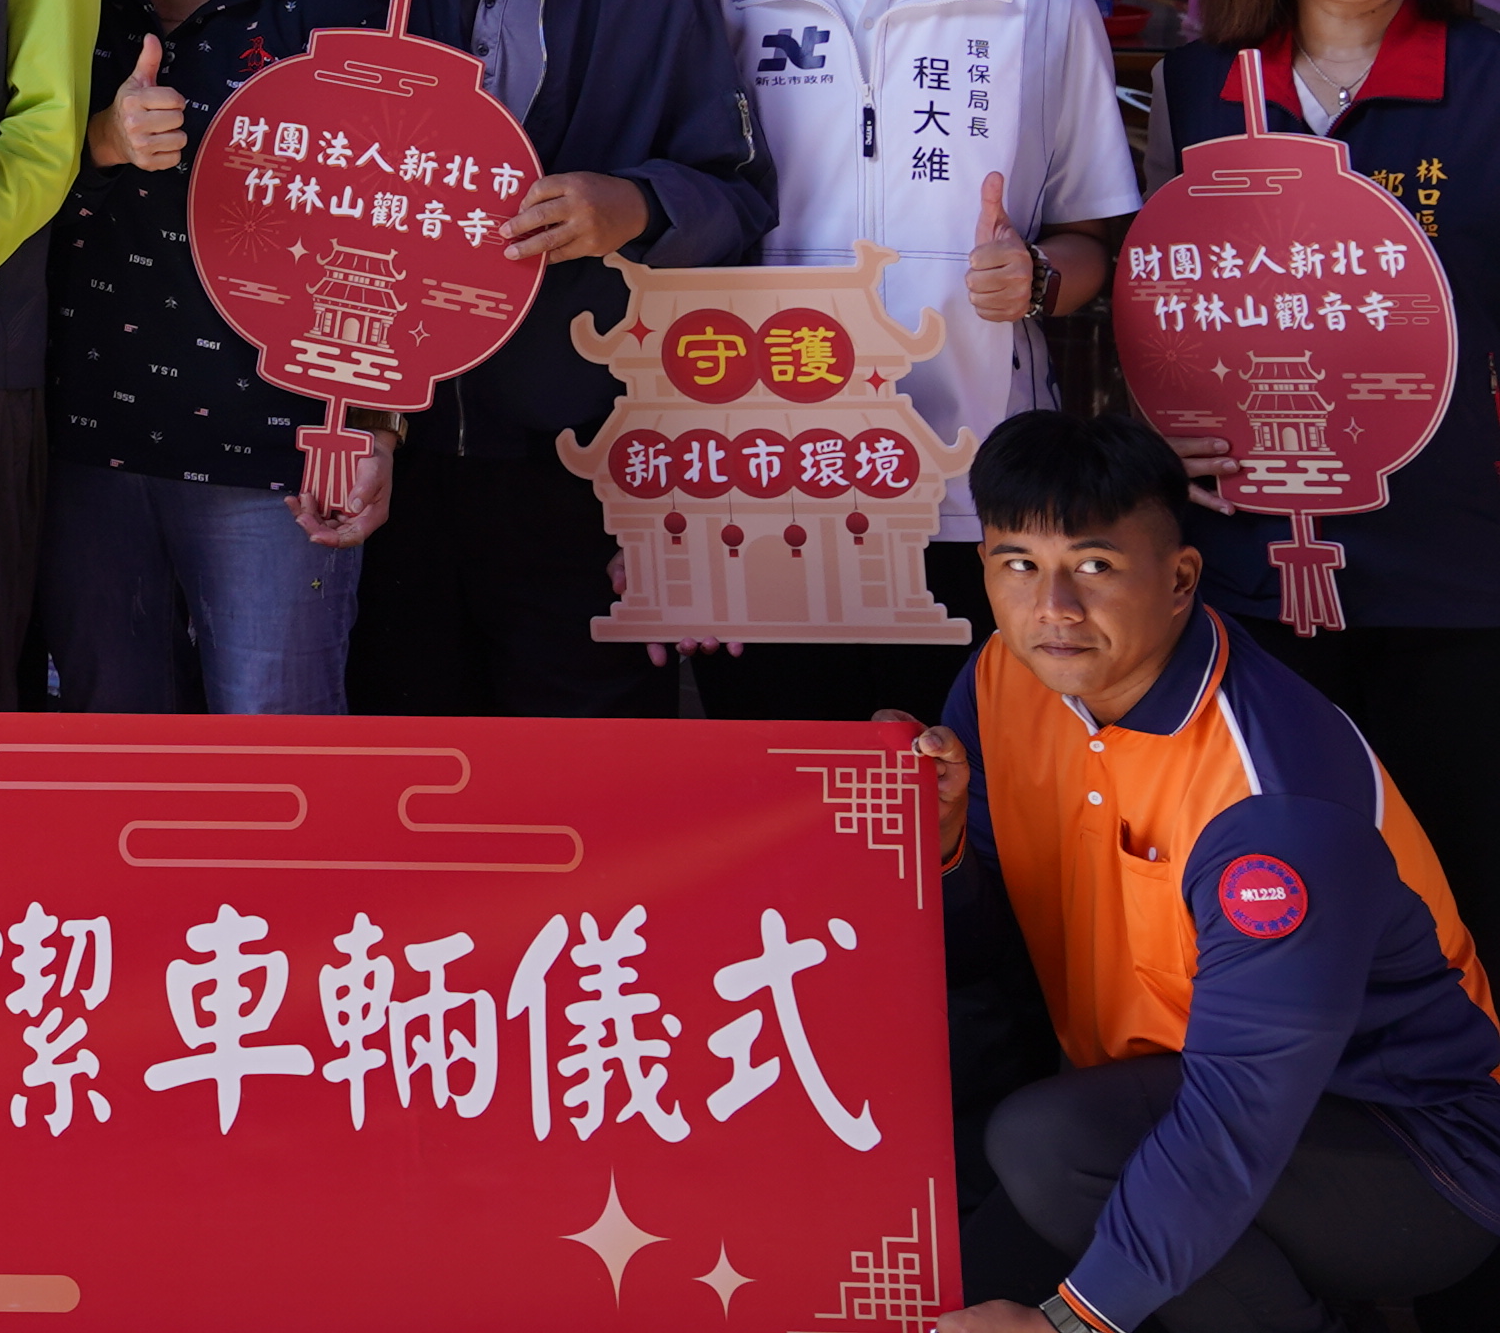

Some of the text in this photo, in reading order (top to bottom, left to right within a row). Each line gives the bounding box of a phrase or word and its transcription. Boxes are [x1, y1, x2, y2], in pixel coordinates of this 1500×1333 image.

[755, 74, 834, 87] 新北市政府
[967, 38, 991, 139] 環保局長
[911, 56, 951, 183] 程大維
[230, 114, 524, 202] 財團法人新北市
[245, 167, 497, 248] 竹林山觀音寺
[1129, 238, 1408, 283] 財團法人新北市
[1154, 290, 1395, 335] 竹林山觀音寺
[676, 324, 844, 385] 守護
[623, 434, 913, 491] 新北市環境
